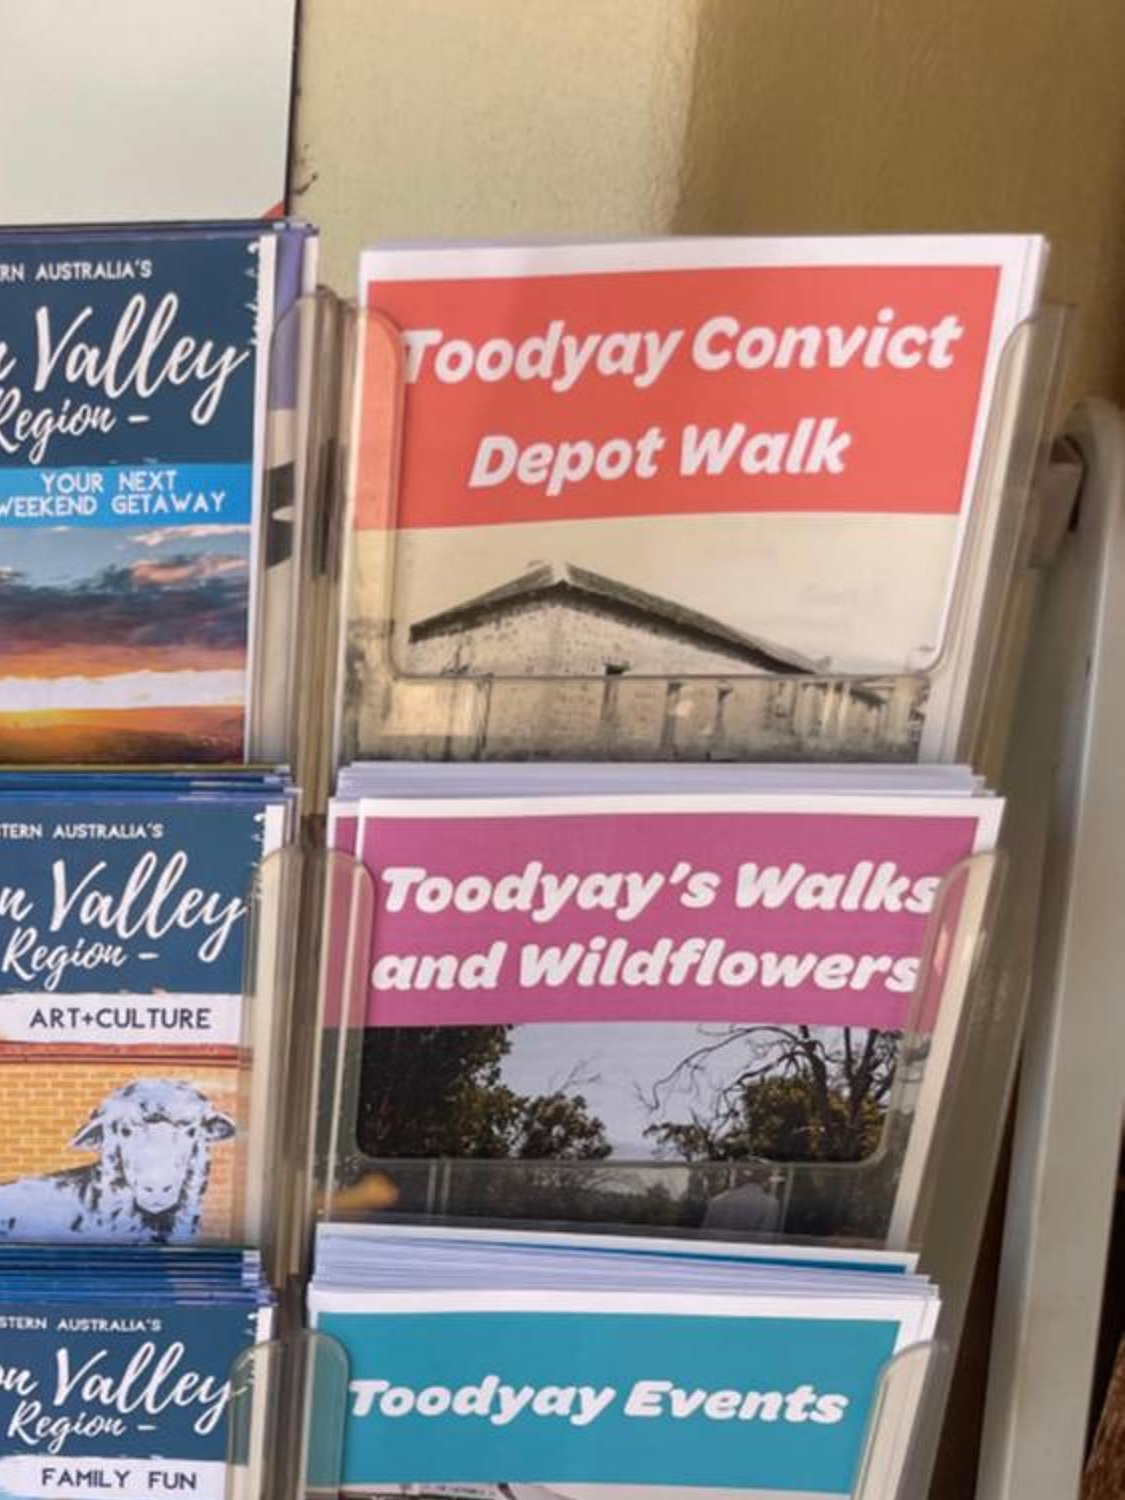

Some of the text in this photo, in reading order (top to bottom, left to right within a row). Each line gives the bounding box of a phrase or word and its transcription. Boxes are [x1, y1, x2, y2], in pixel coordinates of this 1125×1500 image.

[36, 260, 153, 282] AUSTRALIA'S
[35, 294, 250, 426] Valley
[400, 308, 963, 392] Toodyay Convict
[42, 470, 177, 494] YOUR NEXT
[468, 419, 851, 495] Depot Walk
[111, 494, 226, 515] GETAWAY
[53, 823, 163, 840] AUSTRALIA'S
[50, 850, 247, 963] Valley
[381, 862, 942, 922] Toodyay's Walks
[2, 927, 127, 990] Region
[372, 938, 921, 994] and Wildflowers
[29, 1007, 211, 1030] ART+CULTURE
[58, 1317, 162, 1333] AUSTRALIA'S
[54, 1341, 240, 1435] Valley
[348, 1376, 849, 1425] Toodyay Events
[7, 1401, 127, 1454] Region
[42, 1468, 197, 1490] FAMILY FUN
